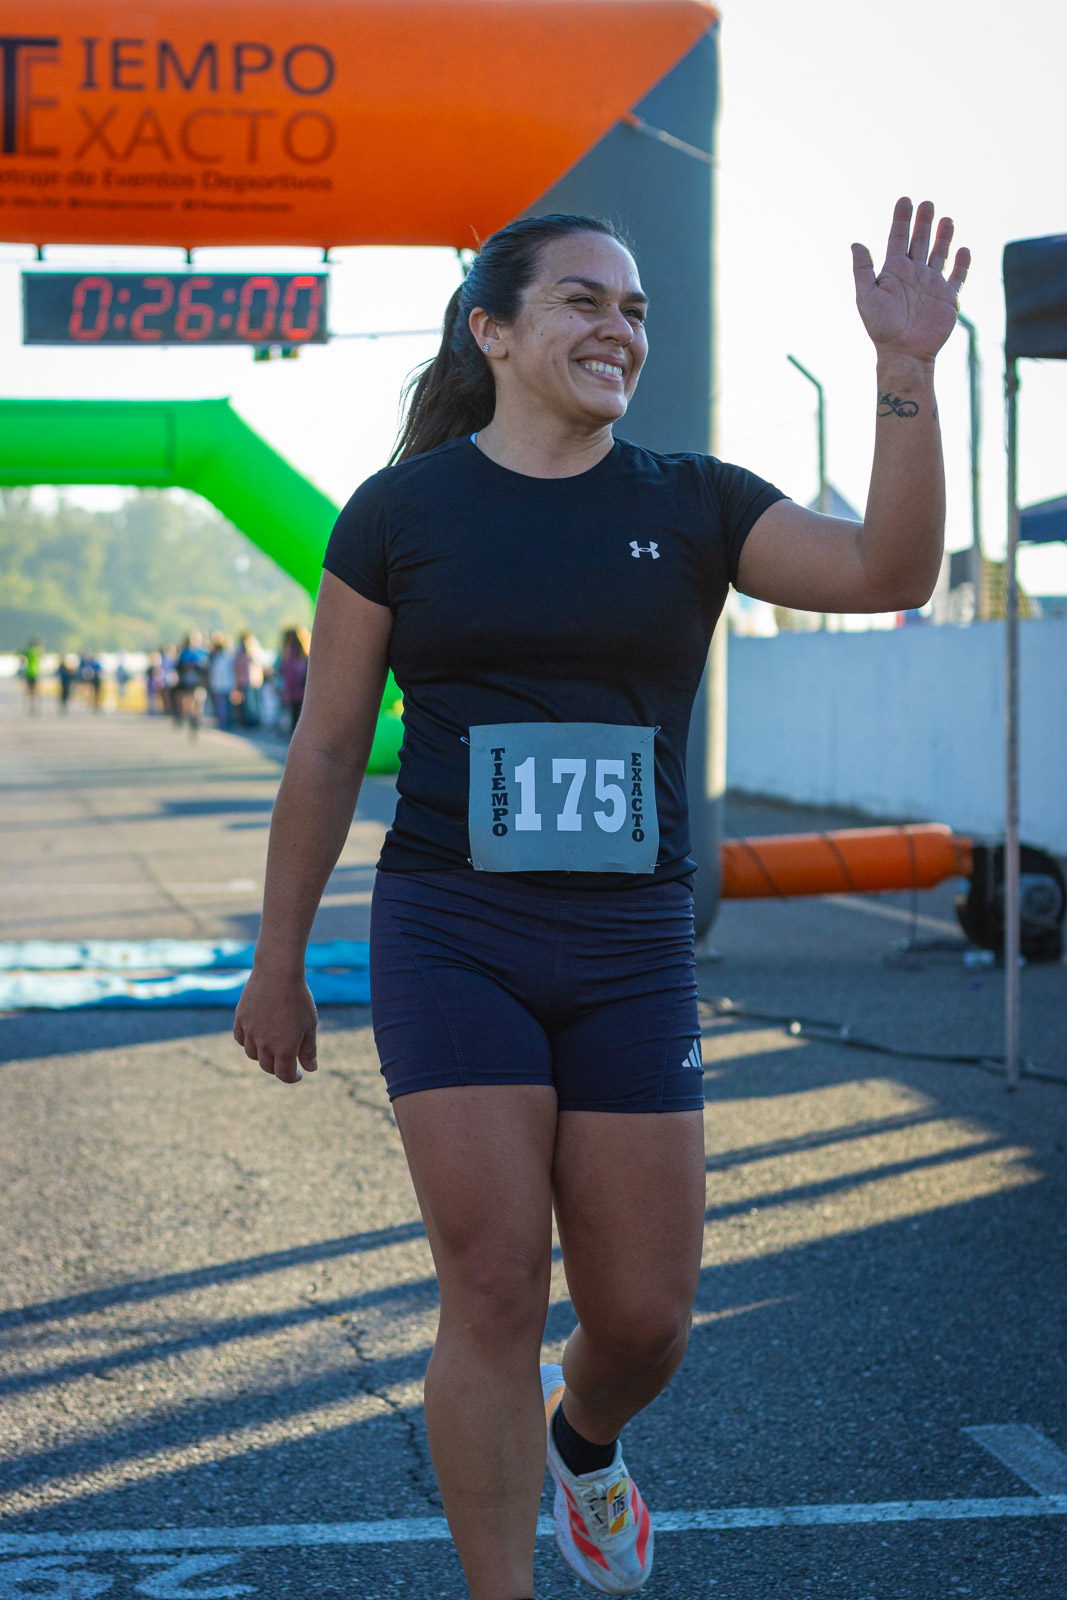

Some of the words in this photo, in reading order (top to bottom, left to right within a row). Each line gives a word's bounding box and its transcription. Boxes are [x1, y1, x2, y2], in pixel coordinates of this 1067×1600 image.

[103, 167, 195, 190] Eventos
[202, 168, 334, 194] Deportivos
[68, 275, 324, 341] 0:26:00
[490, 747, 509, 837] TIEMPO
[514, 756, 627, 833] 175
[631, 752, 645, 843] EXACTO
[612, 1495, 626, 1517] 175
